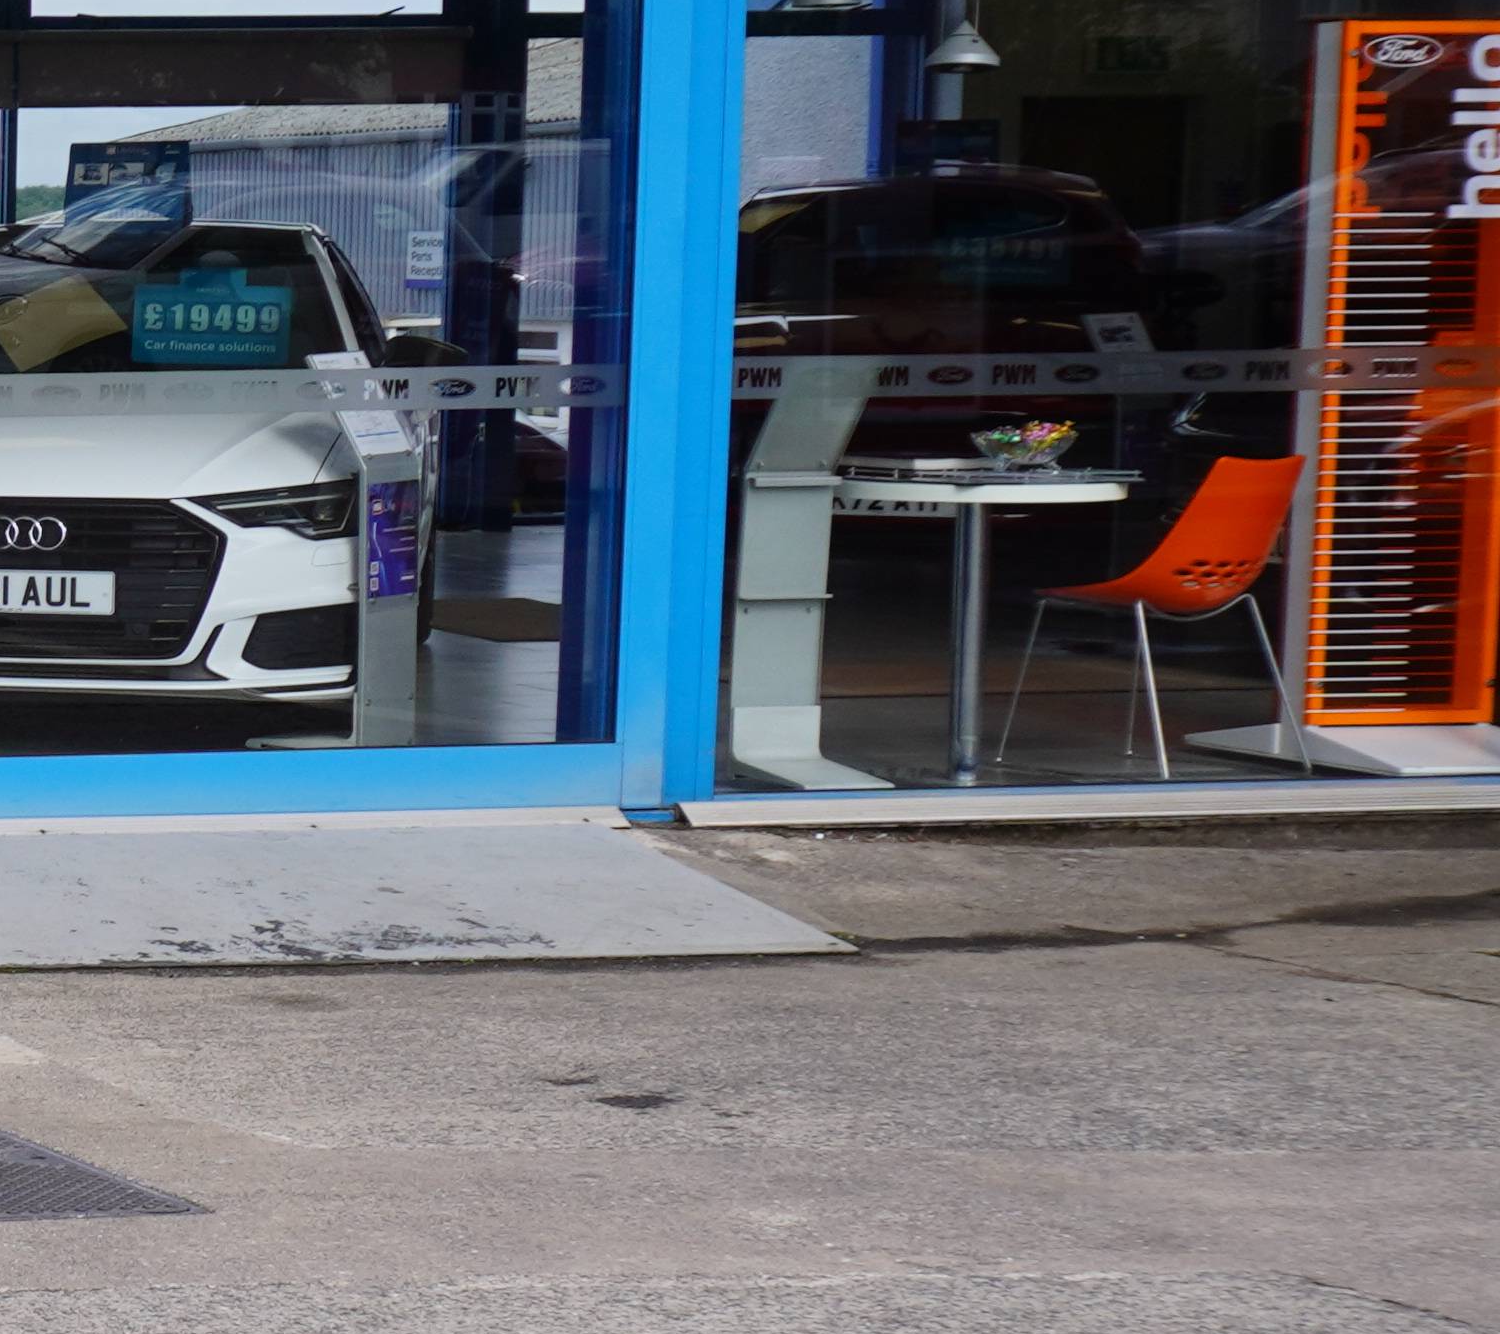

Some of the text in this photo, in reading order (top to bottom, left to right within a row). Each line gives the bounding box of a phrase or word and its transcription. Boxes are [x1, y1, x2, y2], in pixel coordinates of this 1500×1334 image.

[1368, 36, 1439, 65] Ford
[143, 302, 281, 334] £19499
[144, 339, 277, 353] Car finance solutions
[737, 367, 783, 388] PWM
[991, 364, 1037, 385] PWM
[1244, 361, 1291, 381] PWM
[21, 575, 91, 608] AUL
